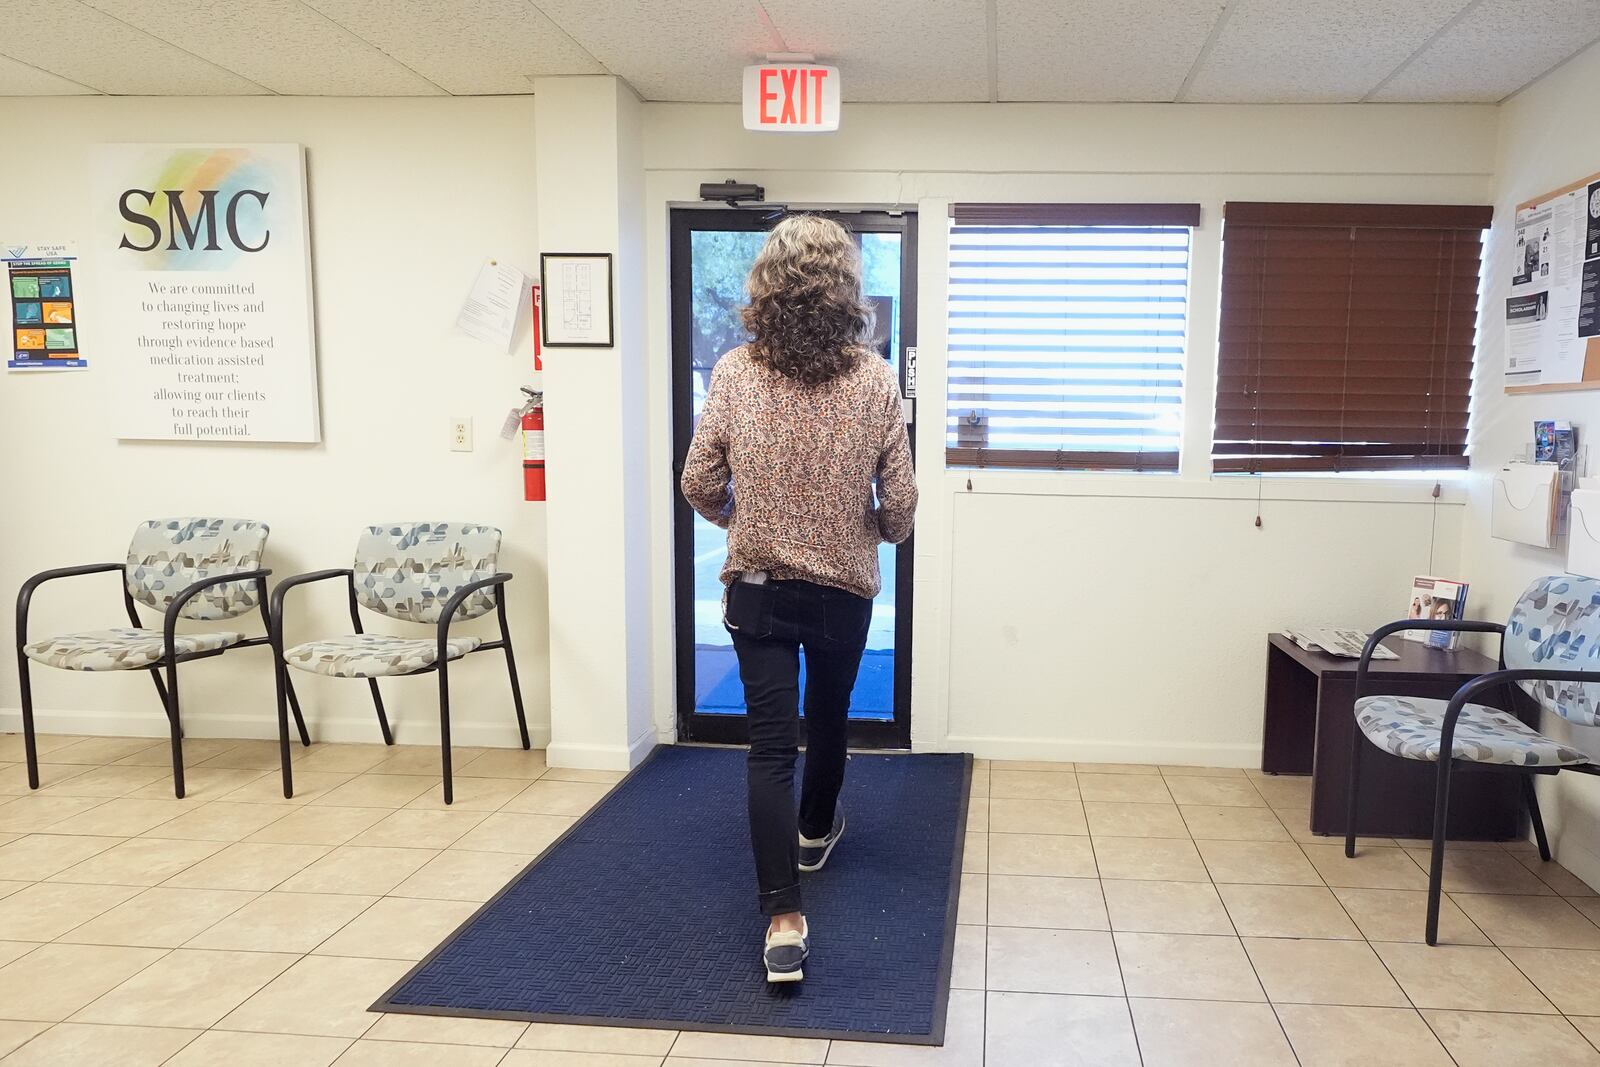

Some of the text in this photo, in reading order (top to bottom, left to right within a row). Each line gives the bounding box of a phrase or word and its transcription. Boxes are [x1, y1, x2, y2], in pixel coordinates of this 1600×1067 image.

[760, 69, 828, 124] EXIT
[118, 189, 271, 253] SMC
[149, 282, 255, 295] We are committed
[142, 300, 264, 315] to changing lives and
[162, 318, 246, 333] restoring hope
[138, 336, 274, 350] through evidence based
[150, 354, 264, 366] medication assisted
[908, 351, 917, 386] PUSH
[178, 372, 239, 384] treatment;
[153, 388, 266, 404] allowing our clients
[172, 407, 249, 418] to reach their
[174, 423, 251, 438] full potential.
